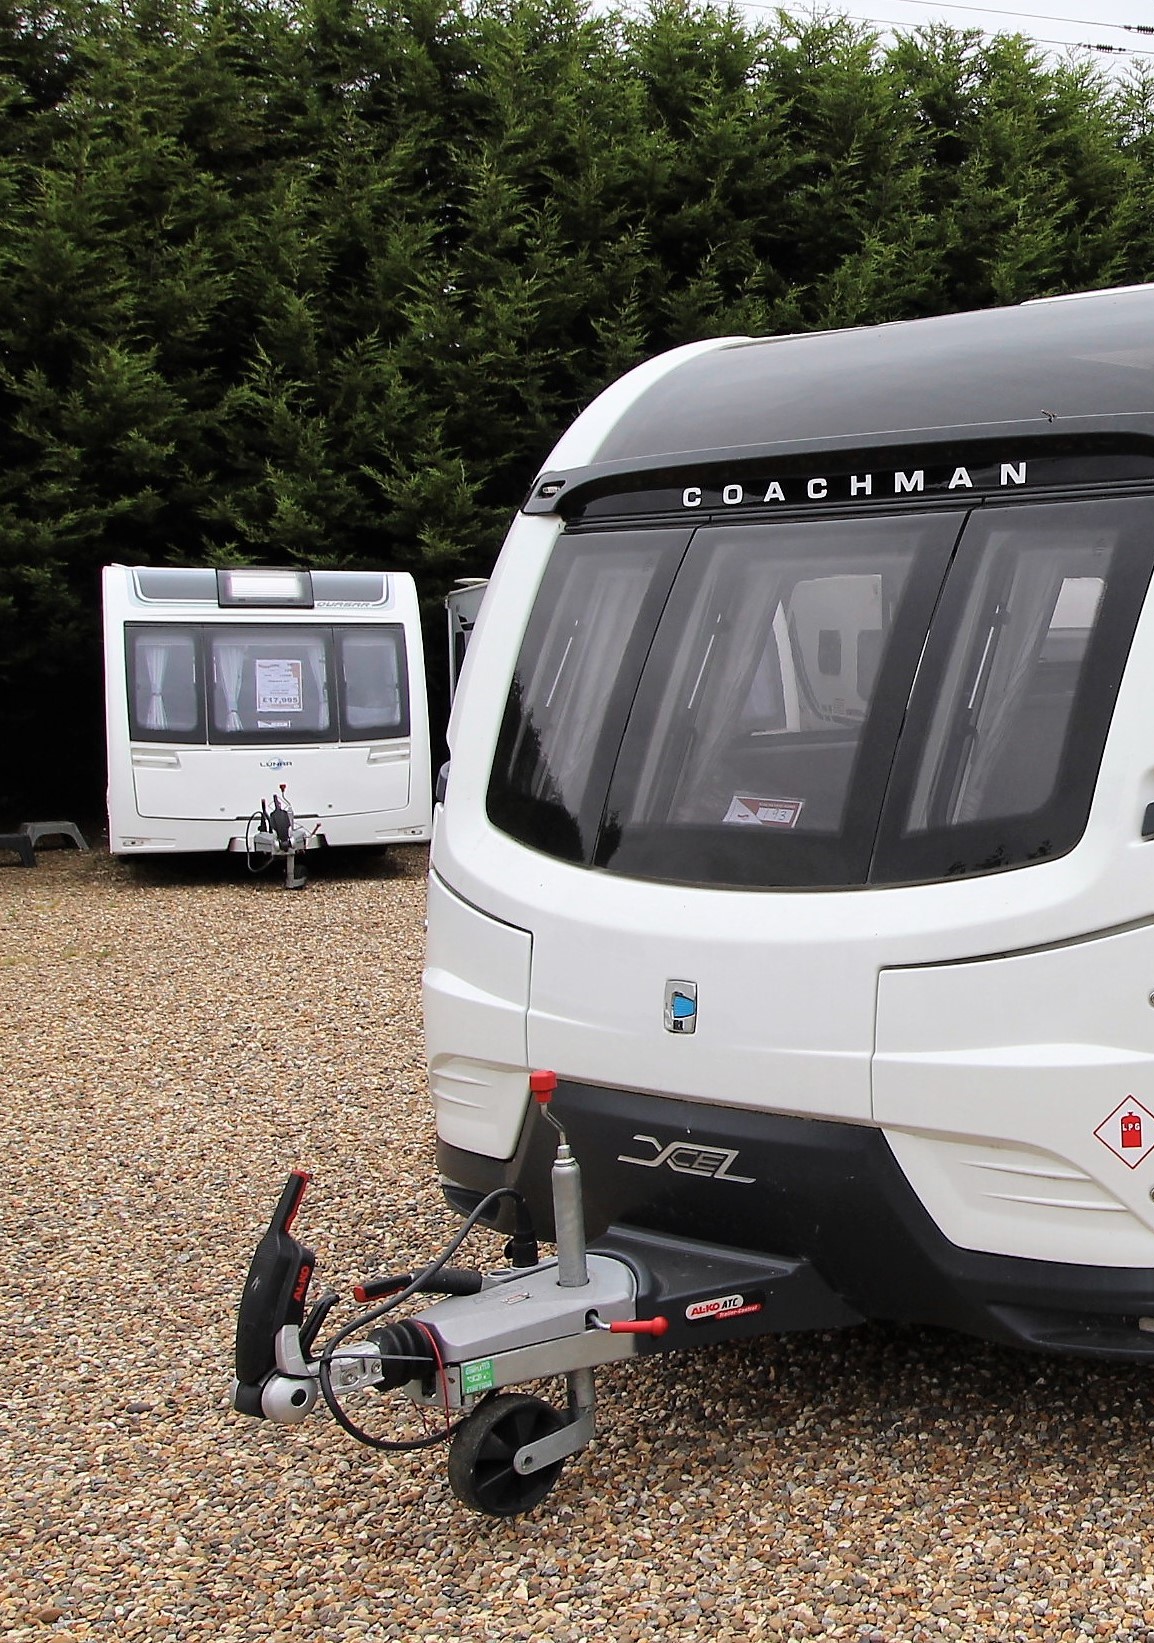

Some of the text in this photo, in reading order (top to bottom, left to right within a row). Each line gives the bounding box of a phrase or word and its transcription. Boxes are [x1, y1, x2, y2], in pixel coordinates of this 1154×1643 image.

[683, 462, 1027, 507] COACHMAN
[1121, 1122, 1141, 1132] LPG
[617, 1134, 757, 1184] XCEL
[721, 1297, 739, 1310] ATC
